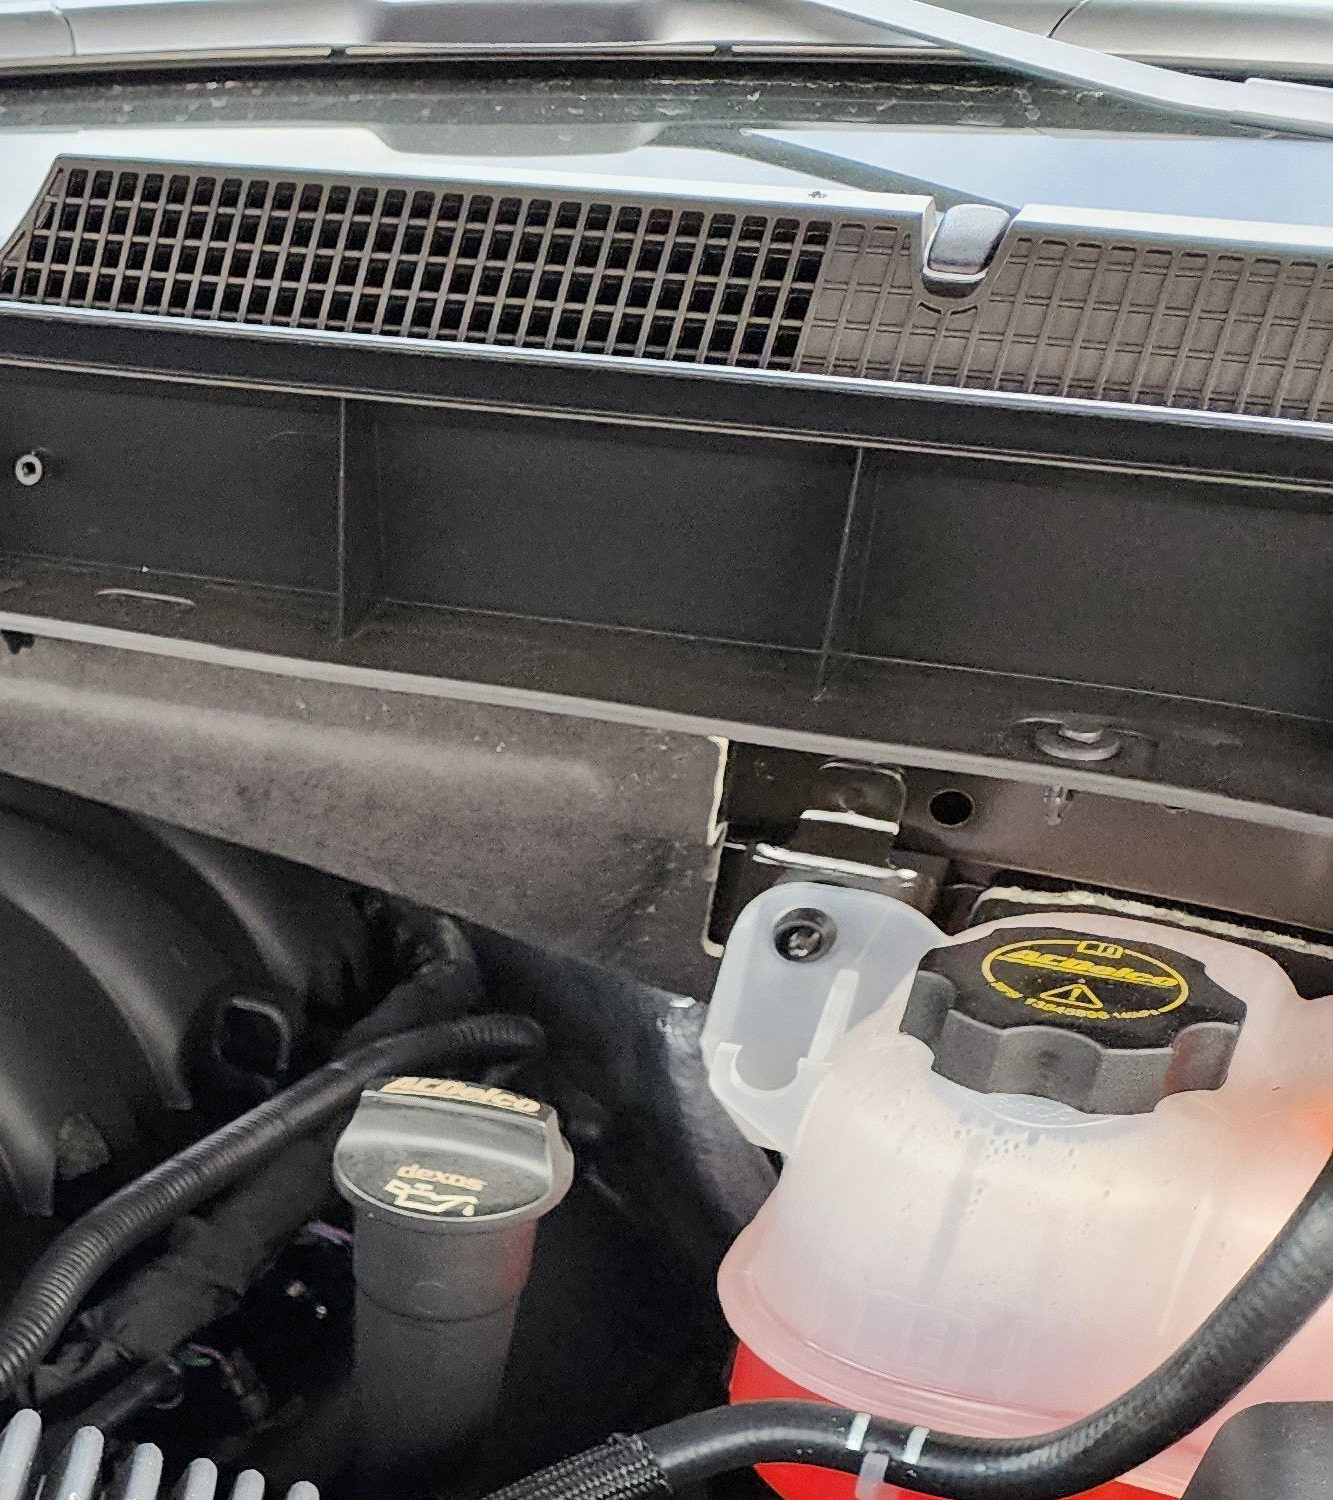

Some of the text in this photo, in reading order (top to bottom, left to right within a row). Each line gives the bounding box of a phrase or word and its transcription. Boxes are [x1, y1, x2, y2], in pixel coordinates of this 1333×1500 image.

[994, 949, 1181, 988] ACDelco
[379, 1076, 541, 1117] ACDelco
[397, 1163, 488, 1192] dexos
